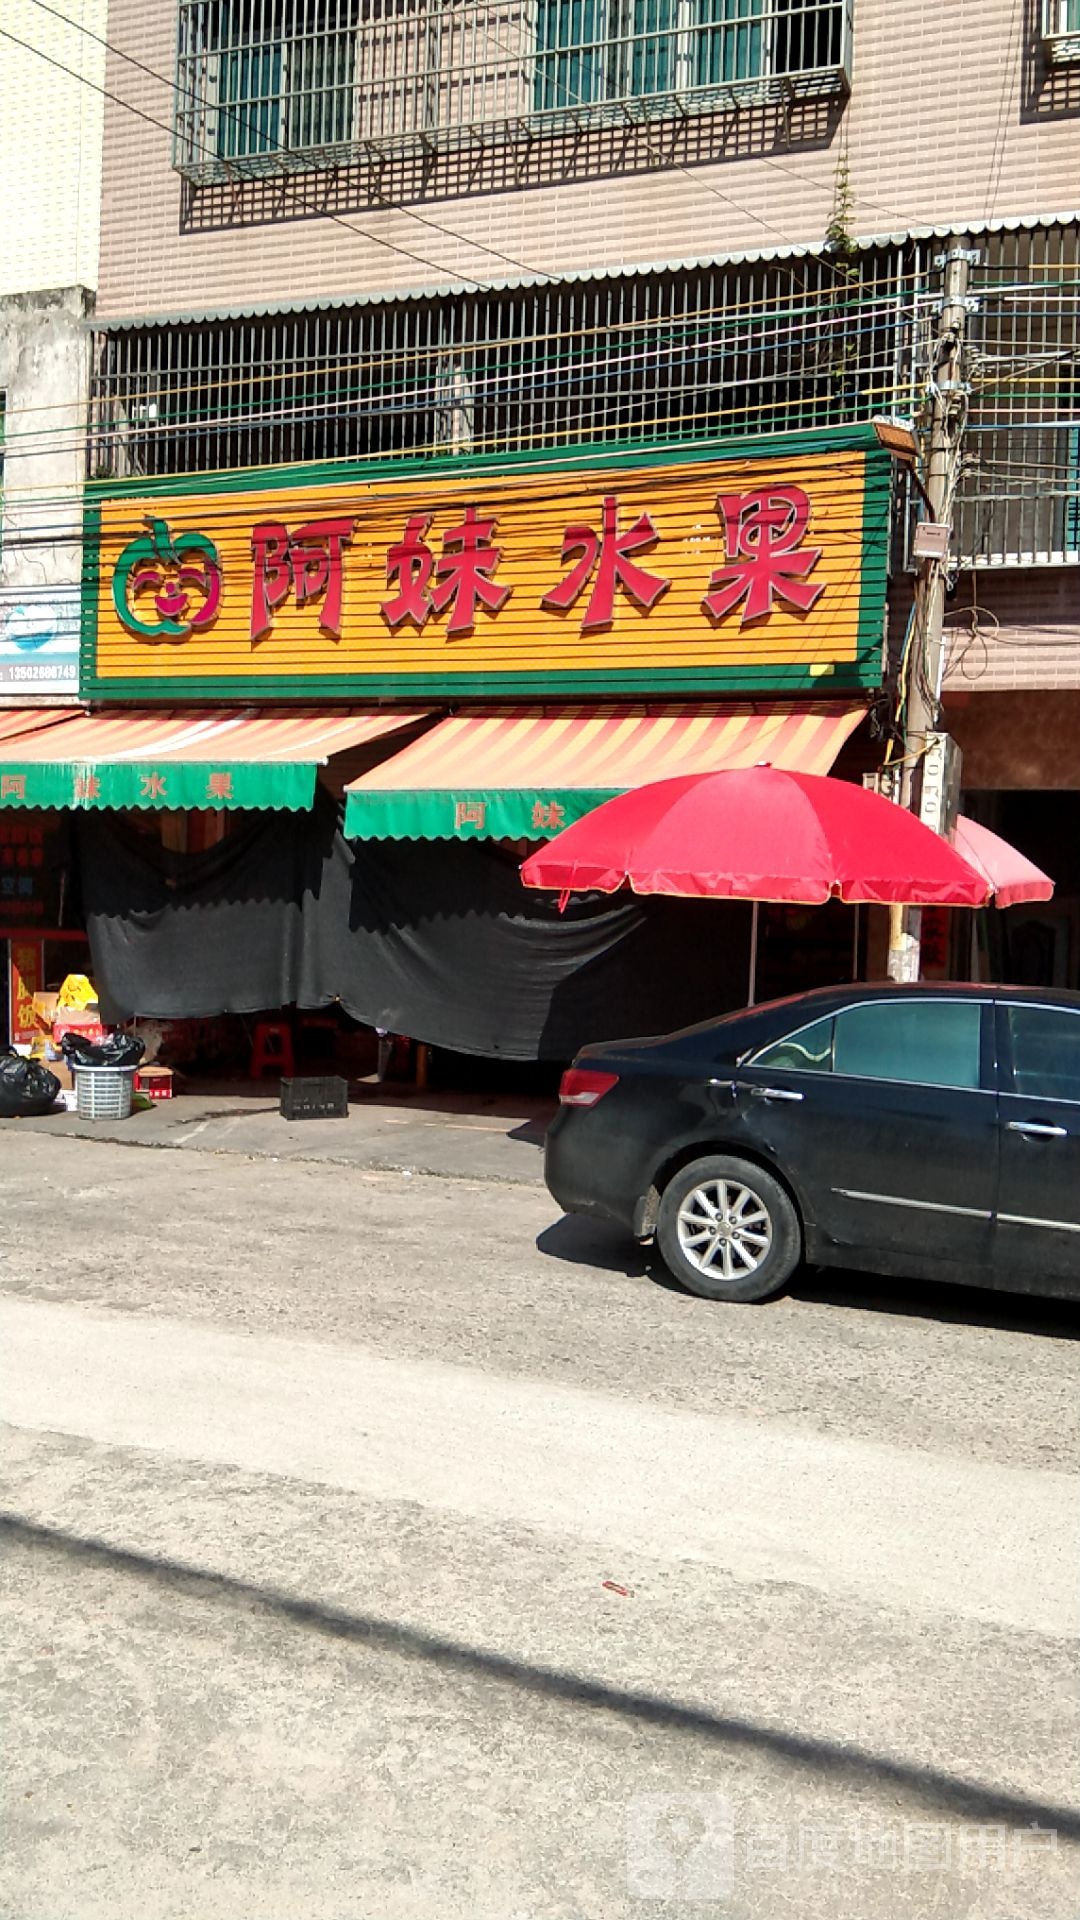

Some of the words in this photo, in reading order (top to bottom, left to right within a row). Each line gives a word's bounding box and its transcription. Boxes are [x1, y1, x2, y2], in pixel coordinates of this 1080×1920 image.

[250, 484, 827, 641] 阿妹水果
[1, 772, 233, 800] 阿妹水果
[455, 800, 566, 830] 阿妹
